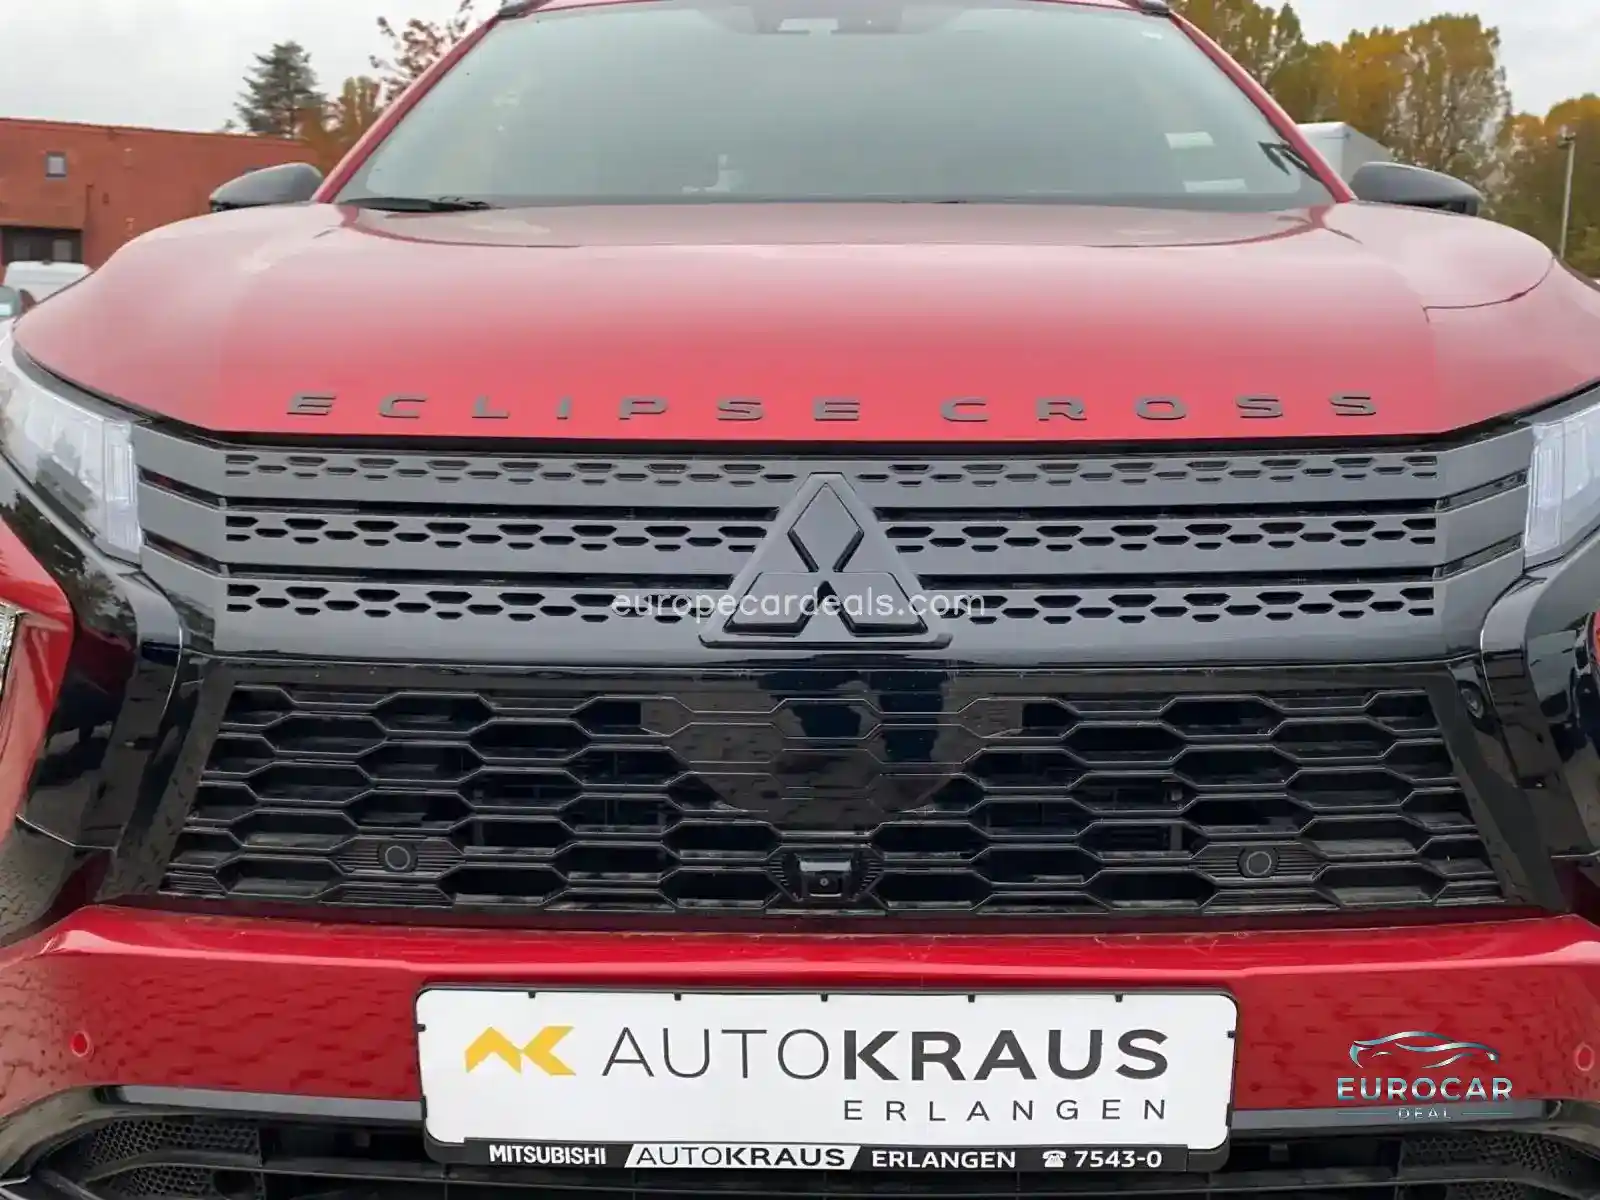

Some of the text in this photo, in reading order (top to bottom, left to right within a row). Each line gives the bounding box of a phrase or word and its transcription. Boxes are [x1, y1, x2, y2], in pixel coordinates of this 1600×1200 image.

[286, 391, 1377, 422] ECLIPSE CROSS
[601, 1025, 1169, 1081] AUTOKRAUS
[843, 1099, 1166, 1122] ERLANGEN
[489, 1143, 1163, 1169] MITSUBISHI AUTOKRAUS ERLANGEN 7543-0
